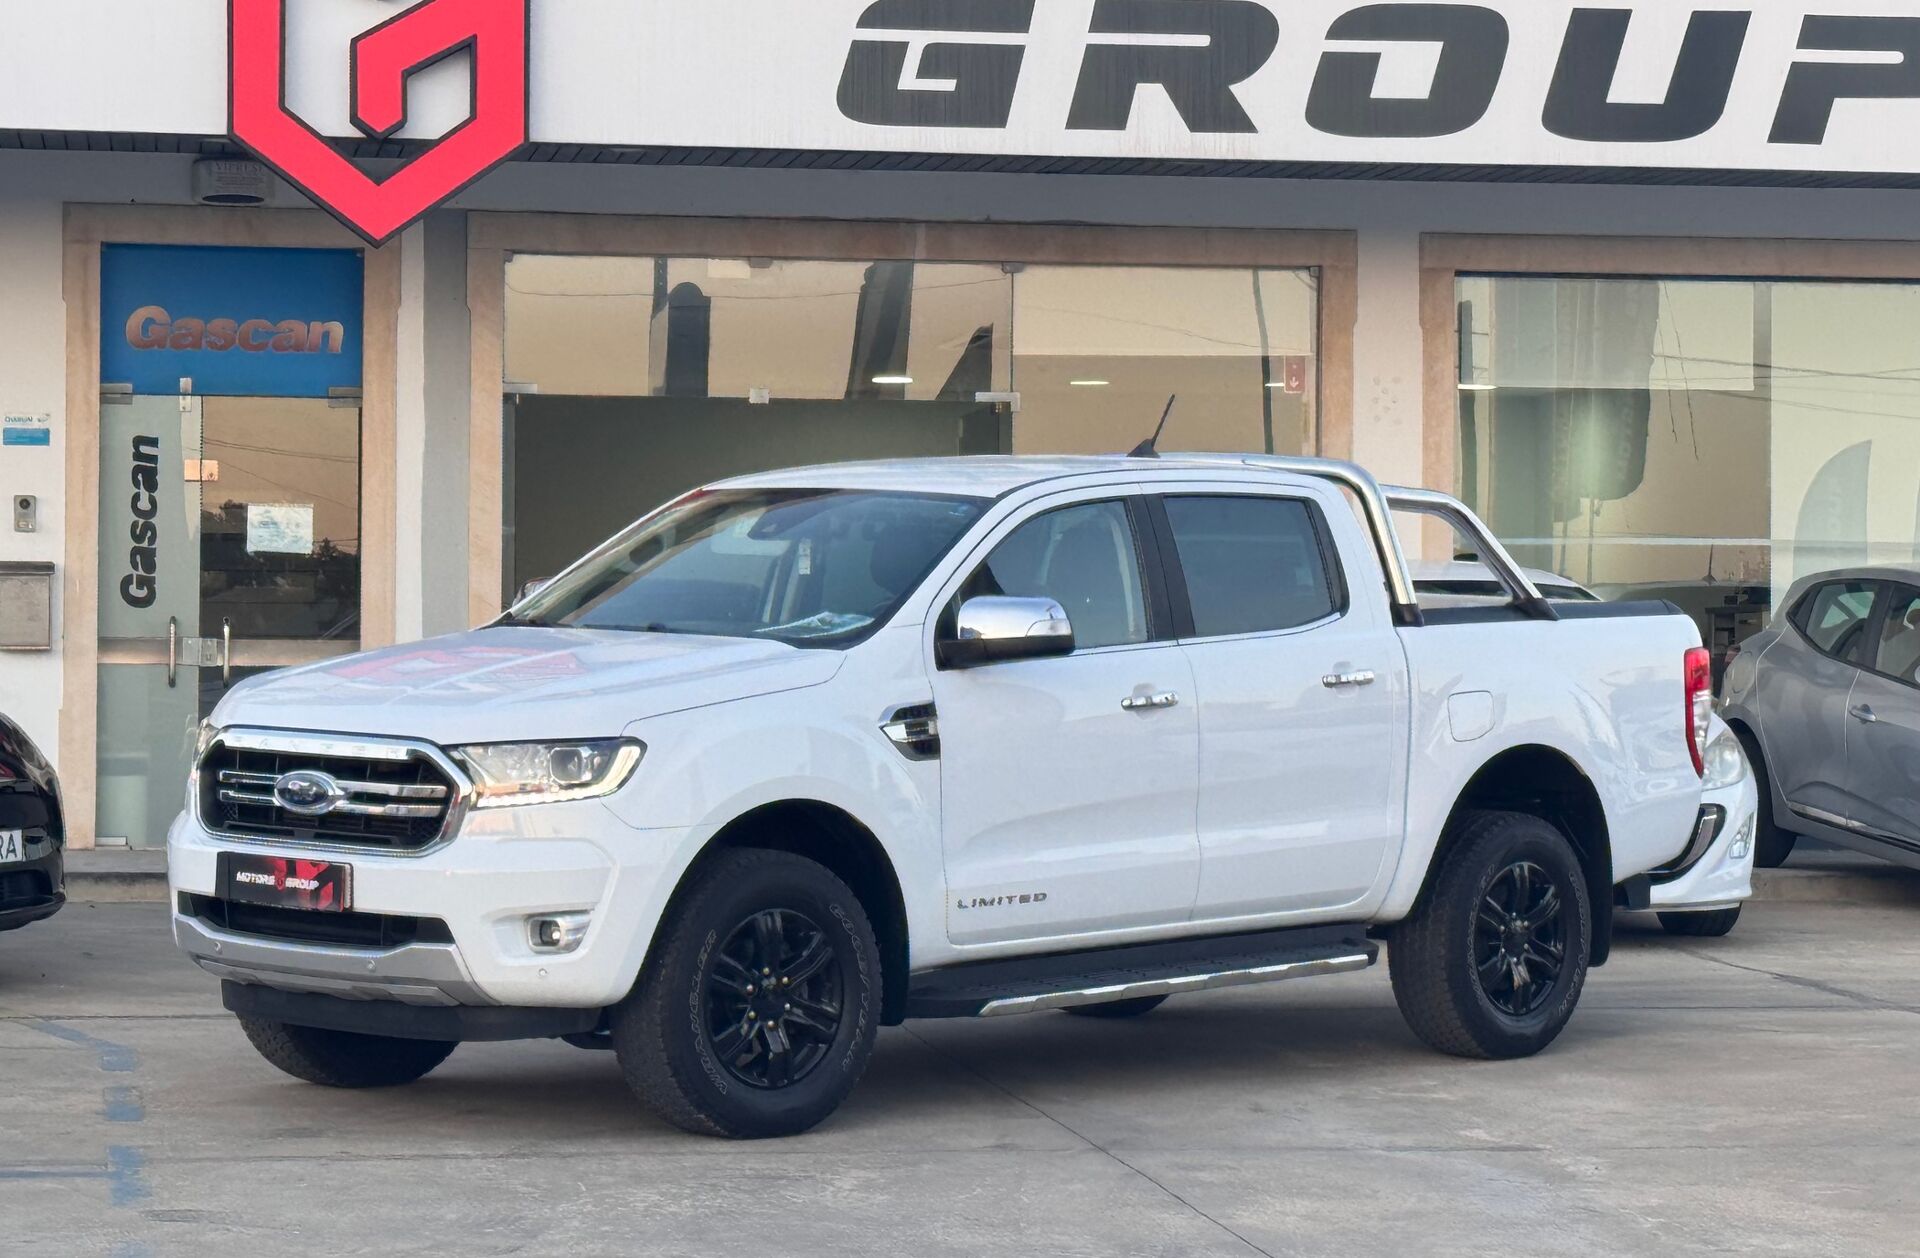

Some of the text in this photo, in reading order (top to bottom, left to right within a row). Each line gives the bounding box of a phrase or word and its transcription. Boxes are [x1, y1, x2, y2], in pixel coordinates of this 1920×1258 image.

[836, 0, 1920, 144] GROUP
[125, 305, 344, 353] Gascan
[119, 434, 159, 608] Gascan
[957, 892, 1048, 910] LIMITED
